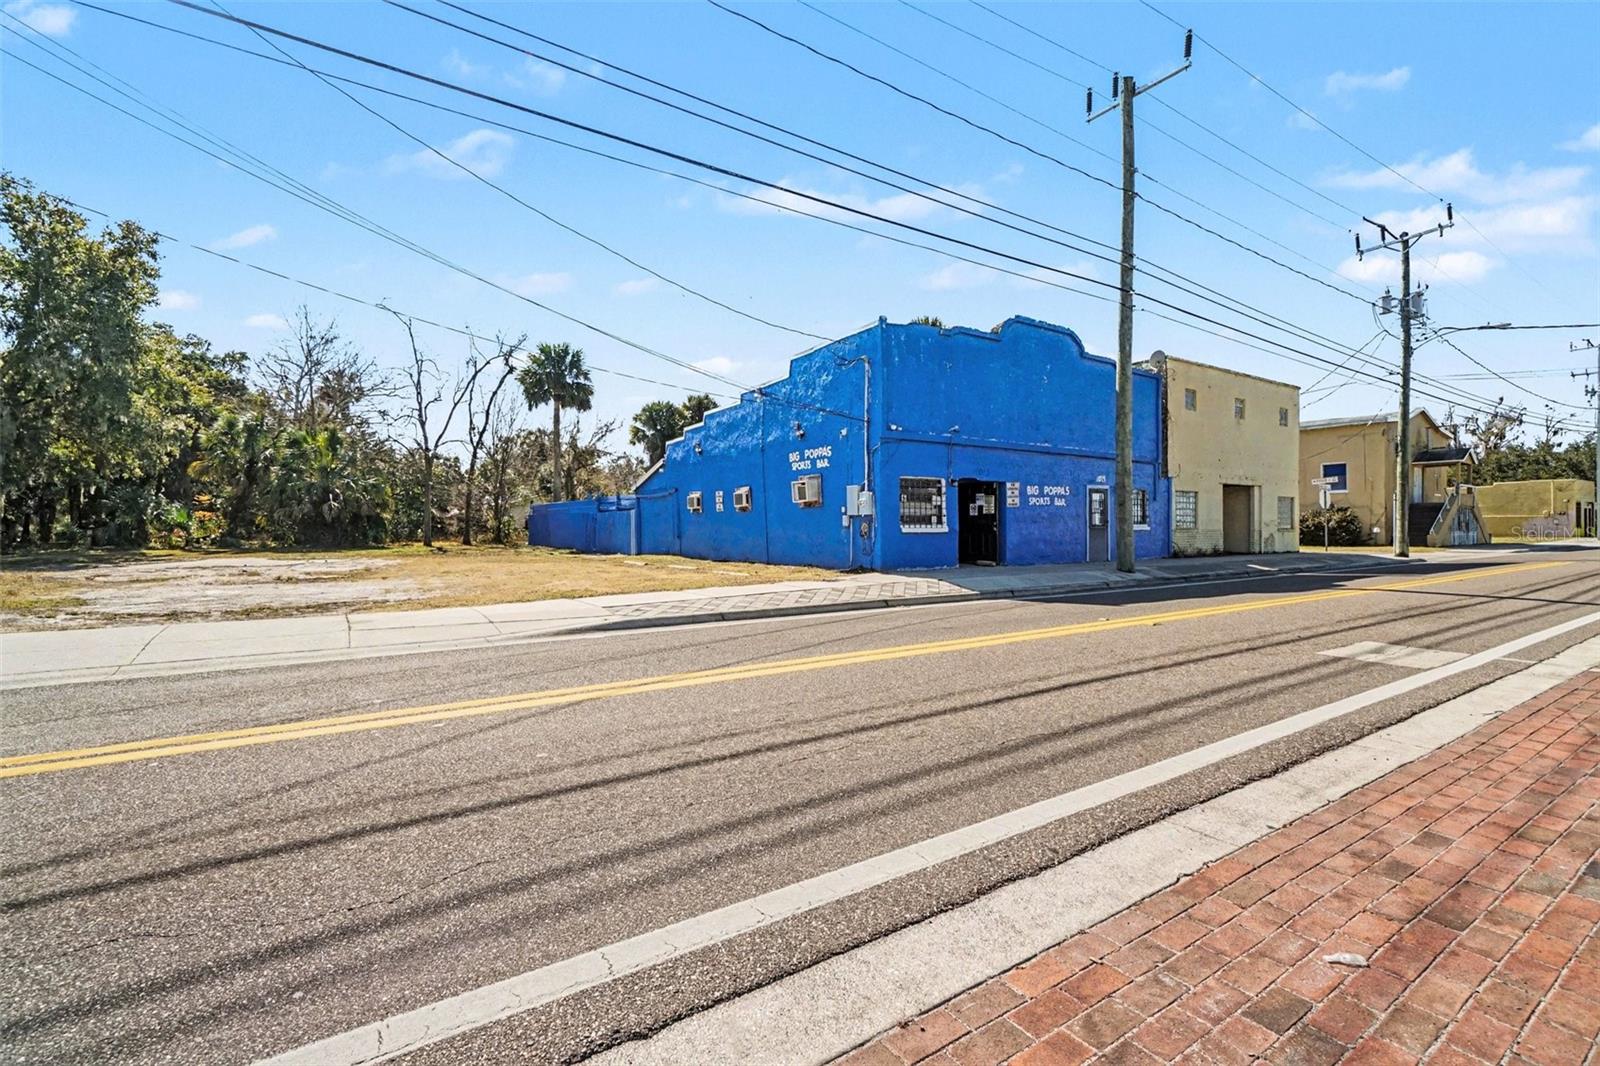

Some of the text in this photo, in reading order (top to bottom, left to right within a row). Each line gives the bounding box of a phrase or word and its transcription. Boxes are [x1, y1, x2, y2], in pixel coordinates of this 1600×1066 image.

[789, 451, 800, 462] BIG
[791, 458, 830, 471] SPORTS BAR
[1026, 485, 1039, 496] BIG
[1028, 497, 1067, 507] SPORTS BAR
